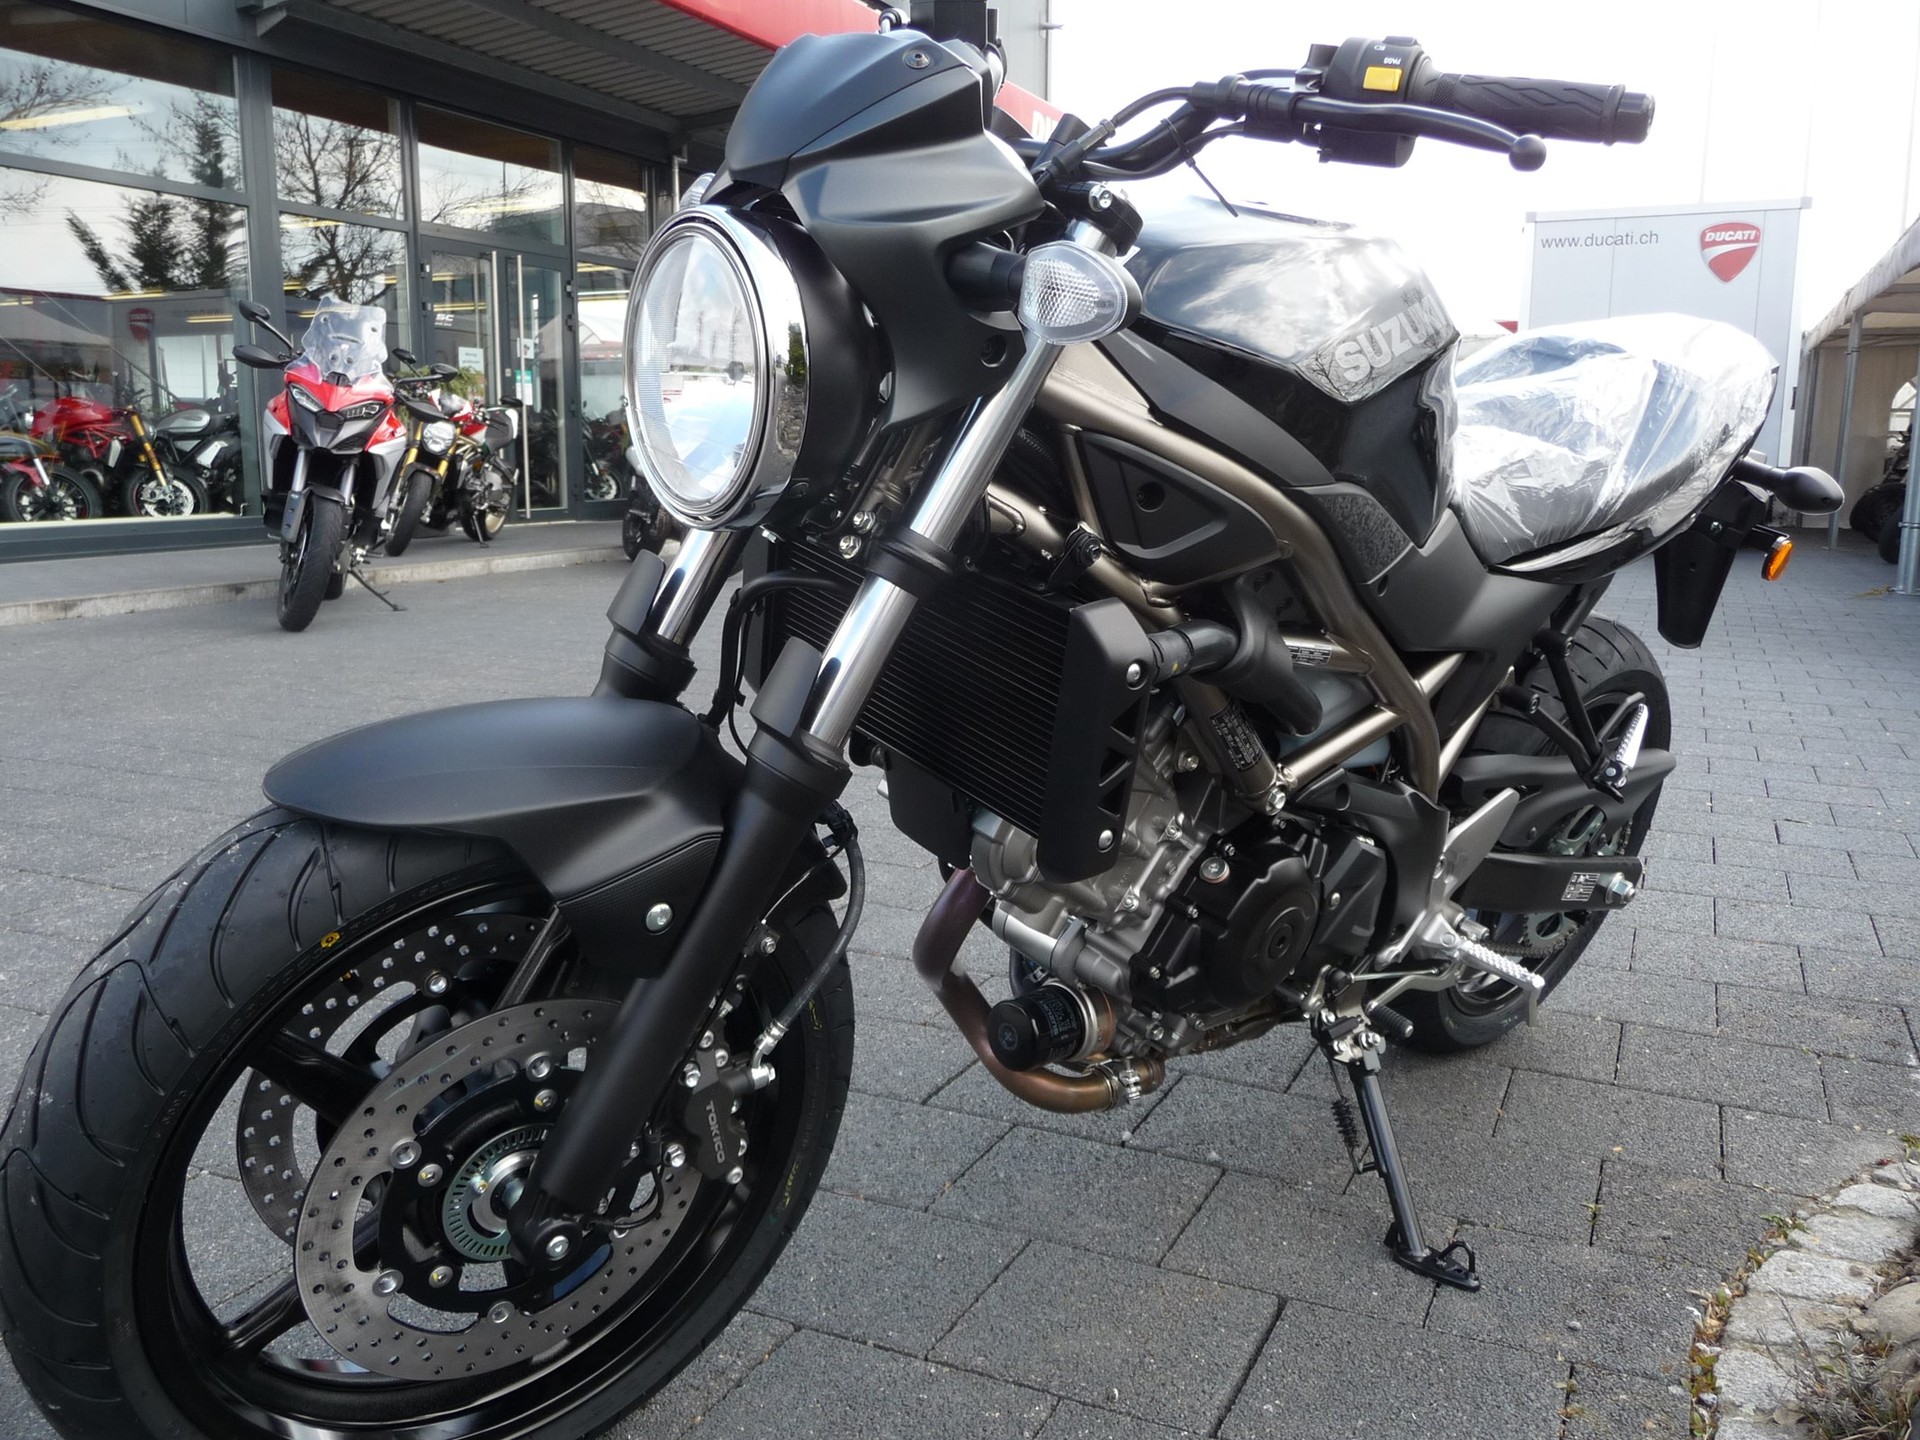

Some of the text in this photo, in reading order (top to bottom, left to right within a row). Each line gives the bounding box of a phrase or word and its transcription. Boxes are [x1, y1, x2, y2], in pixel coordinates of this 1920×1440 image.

[1541, 230, 1659, 249] www.ducati.ch
[1704, 229, 1758, 242] DUCATI
[1334, 294, 1448, 382] SUZUKI
[705, 1100, 726, 1164] TOKICO
